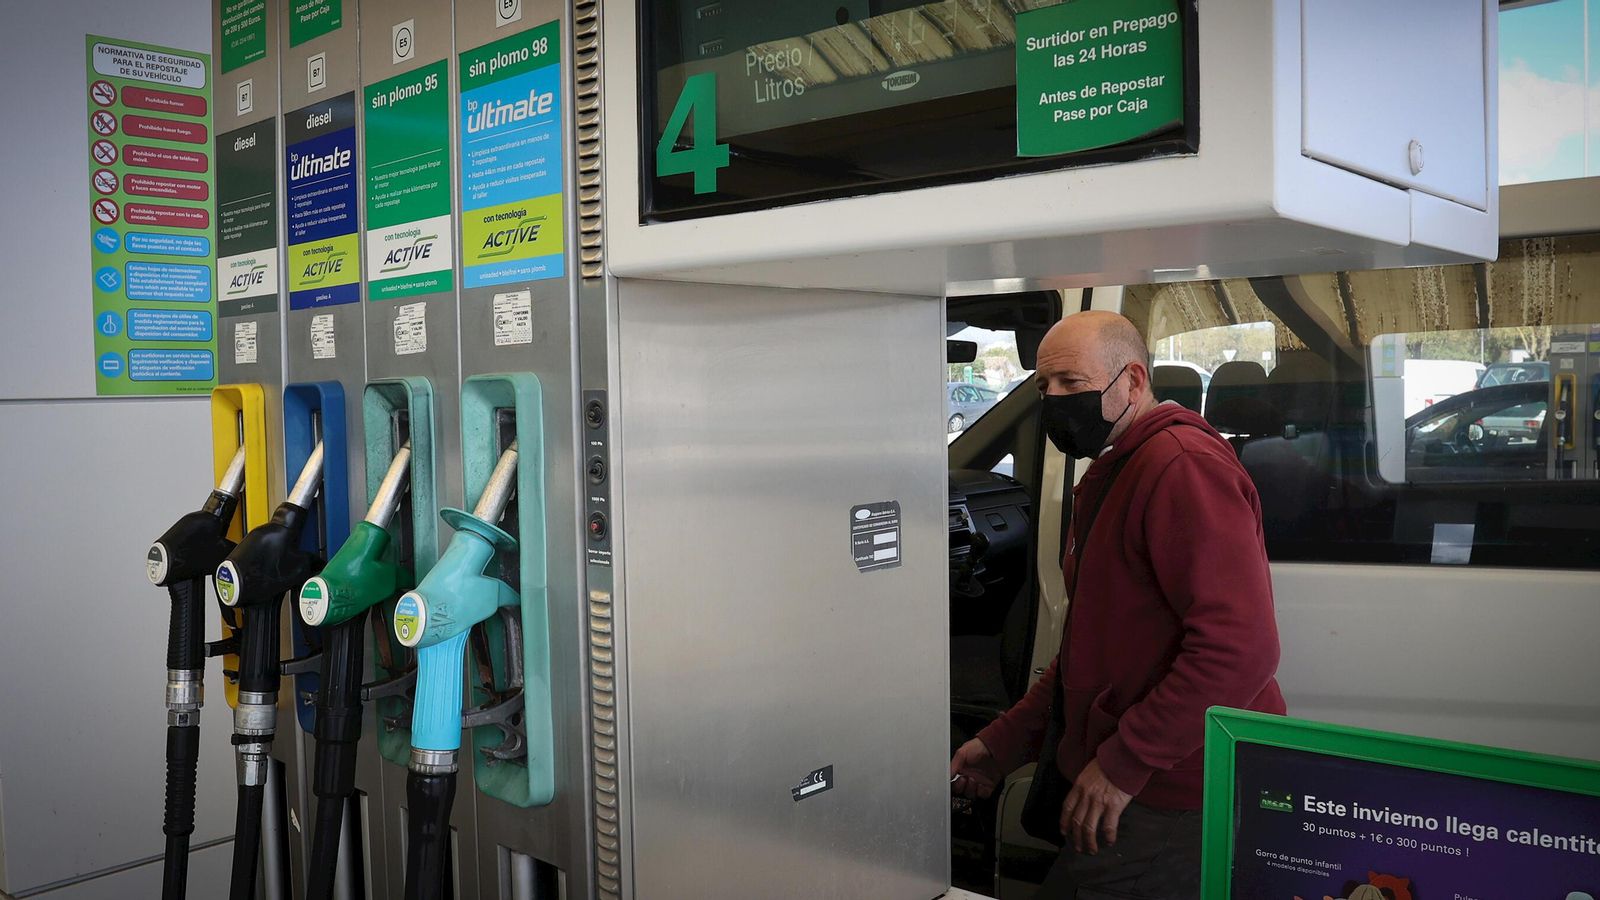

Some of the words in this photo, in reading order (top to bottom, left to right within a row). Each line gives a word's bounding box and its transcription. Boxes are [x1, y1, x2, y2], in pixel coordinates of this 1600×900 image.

[311, 9, 320, 20] por
[319, 5, 330, 15] Caja
[399, 37, 408, 48] E5
[1026, 29, 1085, 52] Surtidor
[1089, 25, 1108, 39] en
[1112, 11, 1178, 35] Prepago
[98, 46, 145, 61] NORMATIVA
[146, 53, 156, 62] DE
[158, 55, 201, 69] SEGURIDAD
[469, 59, 486, 79] sin
[489, 46, 529, 75] plomo
[532, 36, 548, 56] 98
[745, 43, 801, 77] Precio
[1053, 52, 1075, 68] las
[1079, 48, 1097, 64] 24
[1101, 39, 1147, 59] Horas
[112, 57, 133, 67] PARA
[135, 60, 144, 68] EL
[145, 62, 188, 75] REPOSTAJE
[120, 67, 131, 75] DE
[132, 69, 143, 77] SU
[145, 70, 182, 83] VEHÍCULO
[312, 67, 321, 78] B7
[372, 92, 387, 109] sin
[389, 80, 422, 107] plomo
[424, 73, 438, 91] 95
[754, 74, 805, 103] Litros
[1039, 89, 1077, 105] Antes
[1080, 84, 1097, 99] de
[1101, 74, 1165, 96] Repostar
[467, 99, 478, 113] bp
[467, 88, 554, 134] ultimate
[1054, 107, 1086, 123] Pase
[1090, 103, 1114, 120] por
[1117, 97, 1148, 114] Caja
[138, 123, 162, 132] Prohibido
[306, 107, 332, 130] diesel
[233, 131, 256, 152] diesel
[656, 71, 730, 195] 4
[132, 150, 157, 158] Prohibido
[290, 152, 299, 163] bp
[290, 146, 352, 181] ultimate
[131, 178, 156, 186] Prohibido
[130, 207, 155, 215] Prohibido
[483, 214, 495, 224] con
[495, 208, 527, 221] tecnología
[384, 233, 394, 242] con
[482, 224, 542, 250] ACTIVE
[383, 242, 433, 266] ACTIVE
[229, 270, 265, 289] ACTIVE
[302, 258, 344, 278] ACTIVE
[1304, 795, 1347, 817] Este
[1353, 802, 1439, 831] invierno
[1446, 815, 1499, 842] llega
[1303, 822, 1316, 832] 30
[1318, 826, 1356, 840] puntos
[1370, 832, 1384, 843] 1€
[1386, 837, 1393, 845] o
[1396, 837, 1418, 849] 300
[1420, 843, 1462, 857] puntos
[1466, 847, 1470, 857] !
[1256, 848, 1278, 860] Gorro
[1279, 853, 1290, 862] de
[1290, 856, 1314, 868] punto
[1315, 859, 1342, 871] infantil
[1271, 861, 1296, 871] modelos
